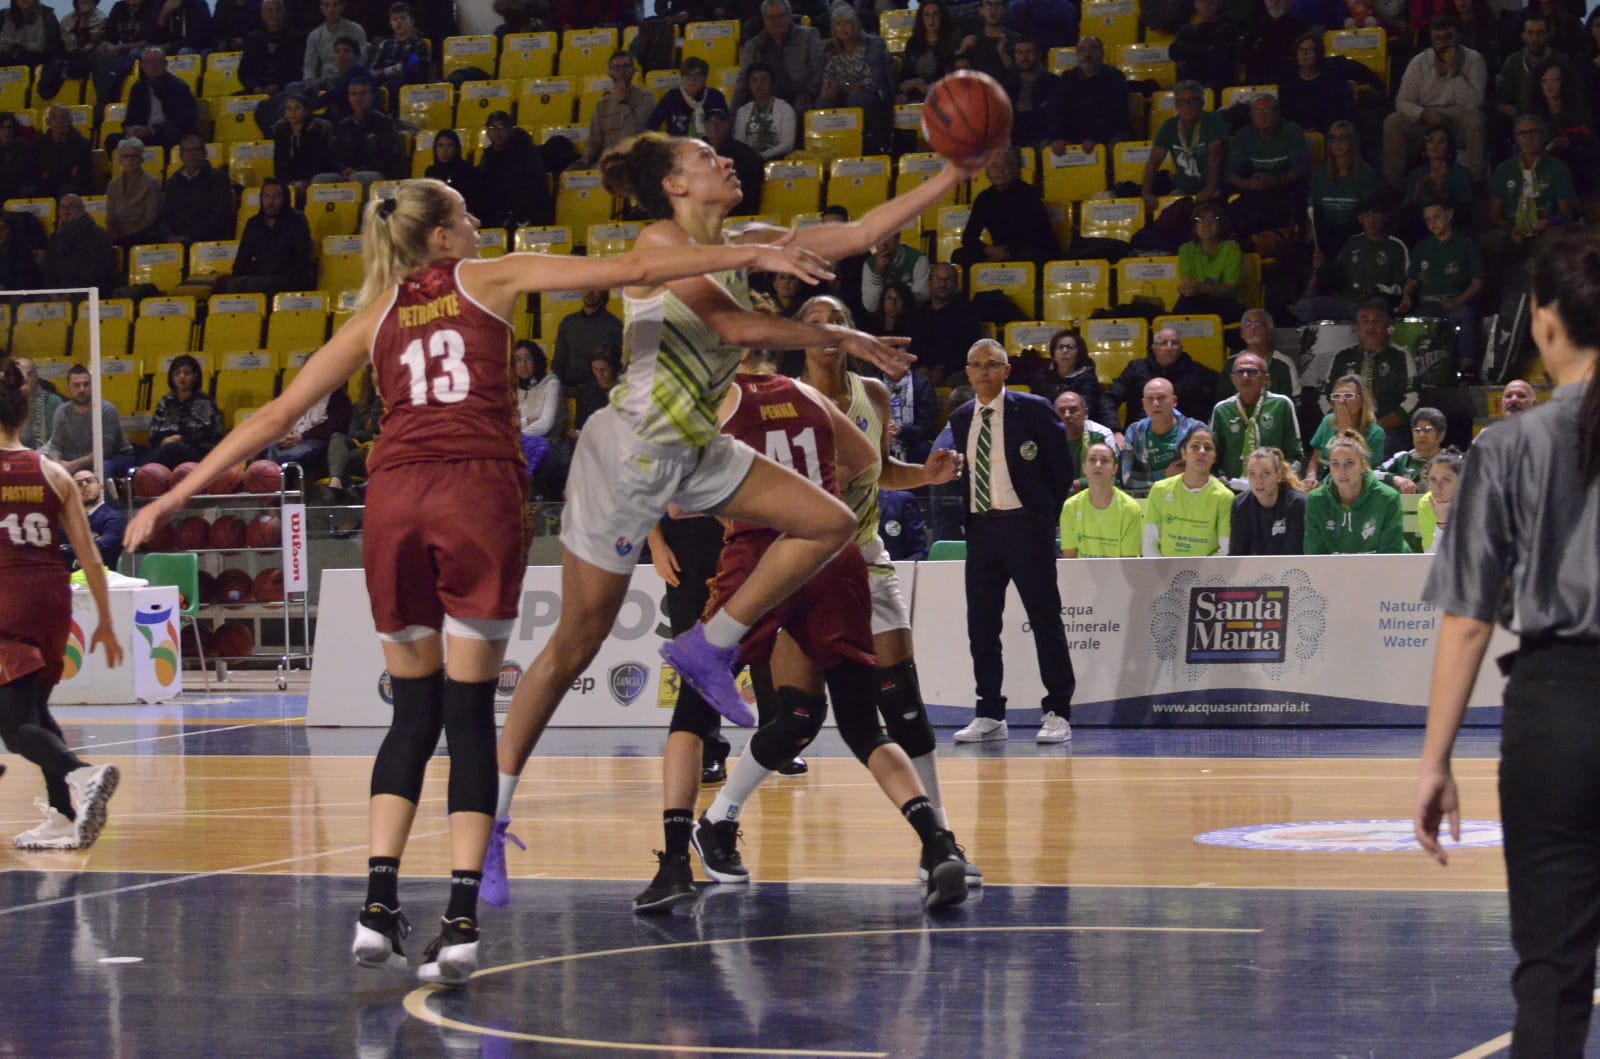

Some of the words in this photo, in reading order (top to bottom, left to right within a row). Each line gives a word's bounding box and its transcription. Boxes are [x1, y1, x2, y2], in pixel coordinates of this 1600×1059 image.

[400, 329, 471, 406] 13
[765, 427, 823, 487] 41
[291, 513, 302, 581] Wilson
[1060, 606, 1093, 619] cqua
[1195, 591, 1283, 621] Santa
[1380, 601, 1436, 612] Natural
[1378, 616, 1435, 630] Mineral
[1192, 622, 1281, 650] Maria
[1384, 636, 1429, 648] Water
[1067, 638, 1101, 650] urale
[571, 677, 596, 694] ep
[1152, 702, 1311, 716] www.acquasantamaria.it
